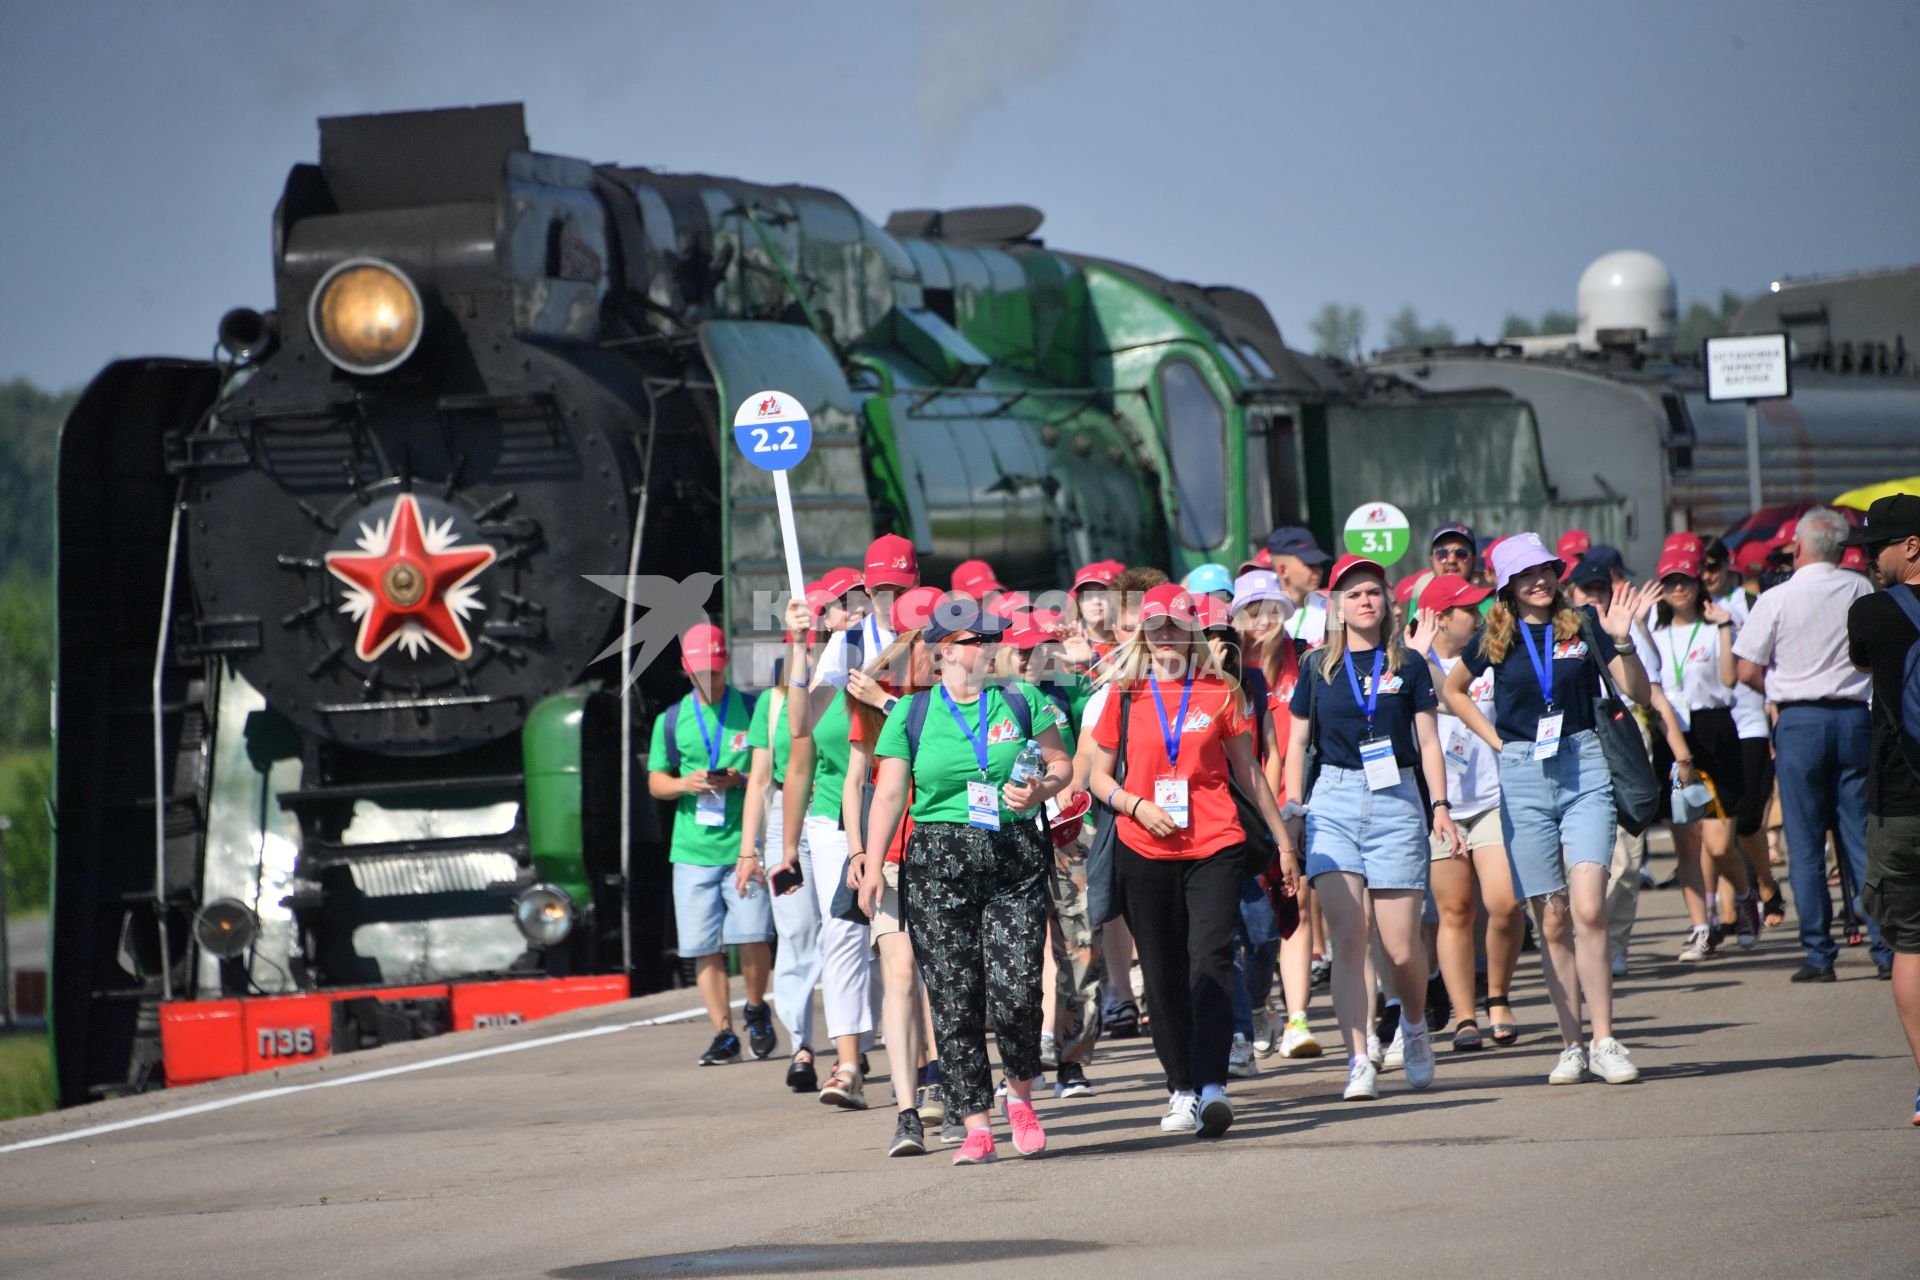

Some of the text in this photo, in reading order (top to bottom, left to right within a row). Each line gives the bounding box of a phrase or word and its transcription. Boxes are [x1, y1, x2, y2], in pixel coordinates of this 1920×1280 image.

[751, 426, 798, 452] 2.2
[1361, 531, 1393, 552] 3.1
[257, 1028, 314, 1058] П36
